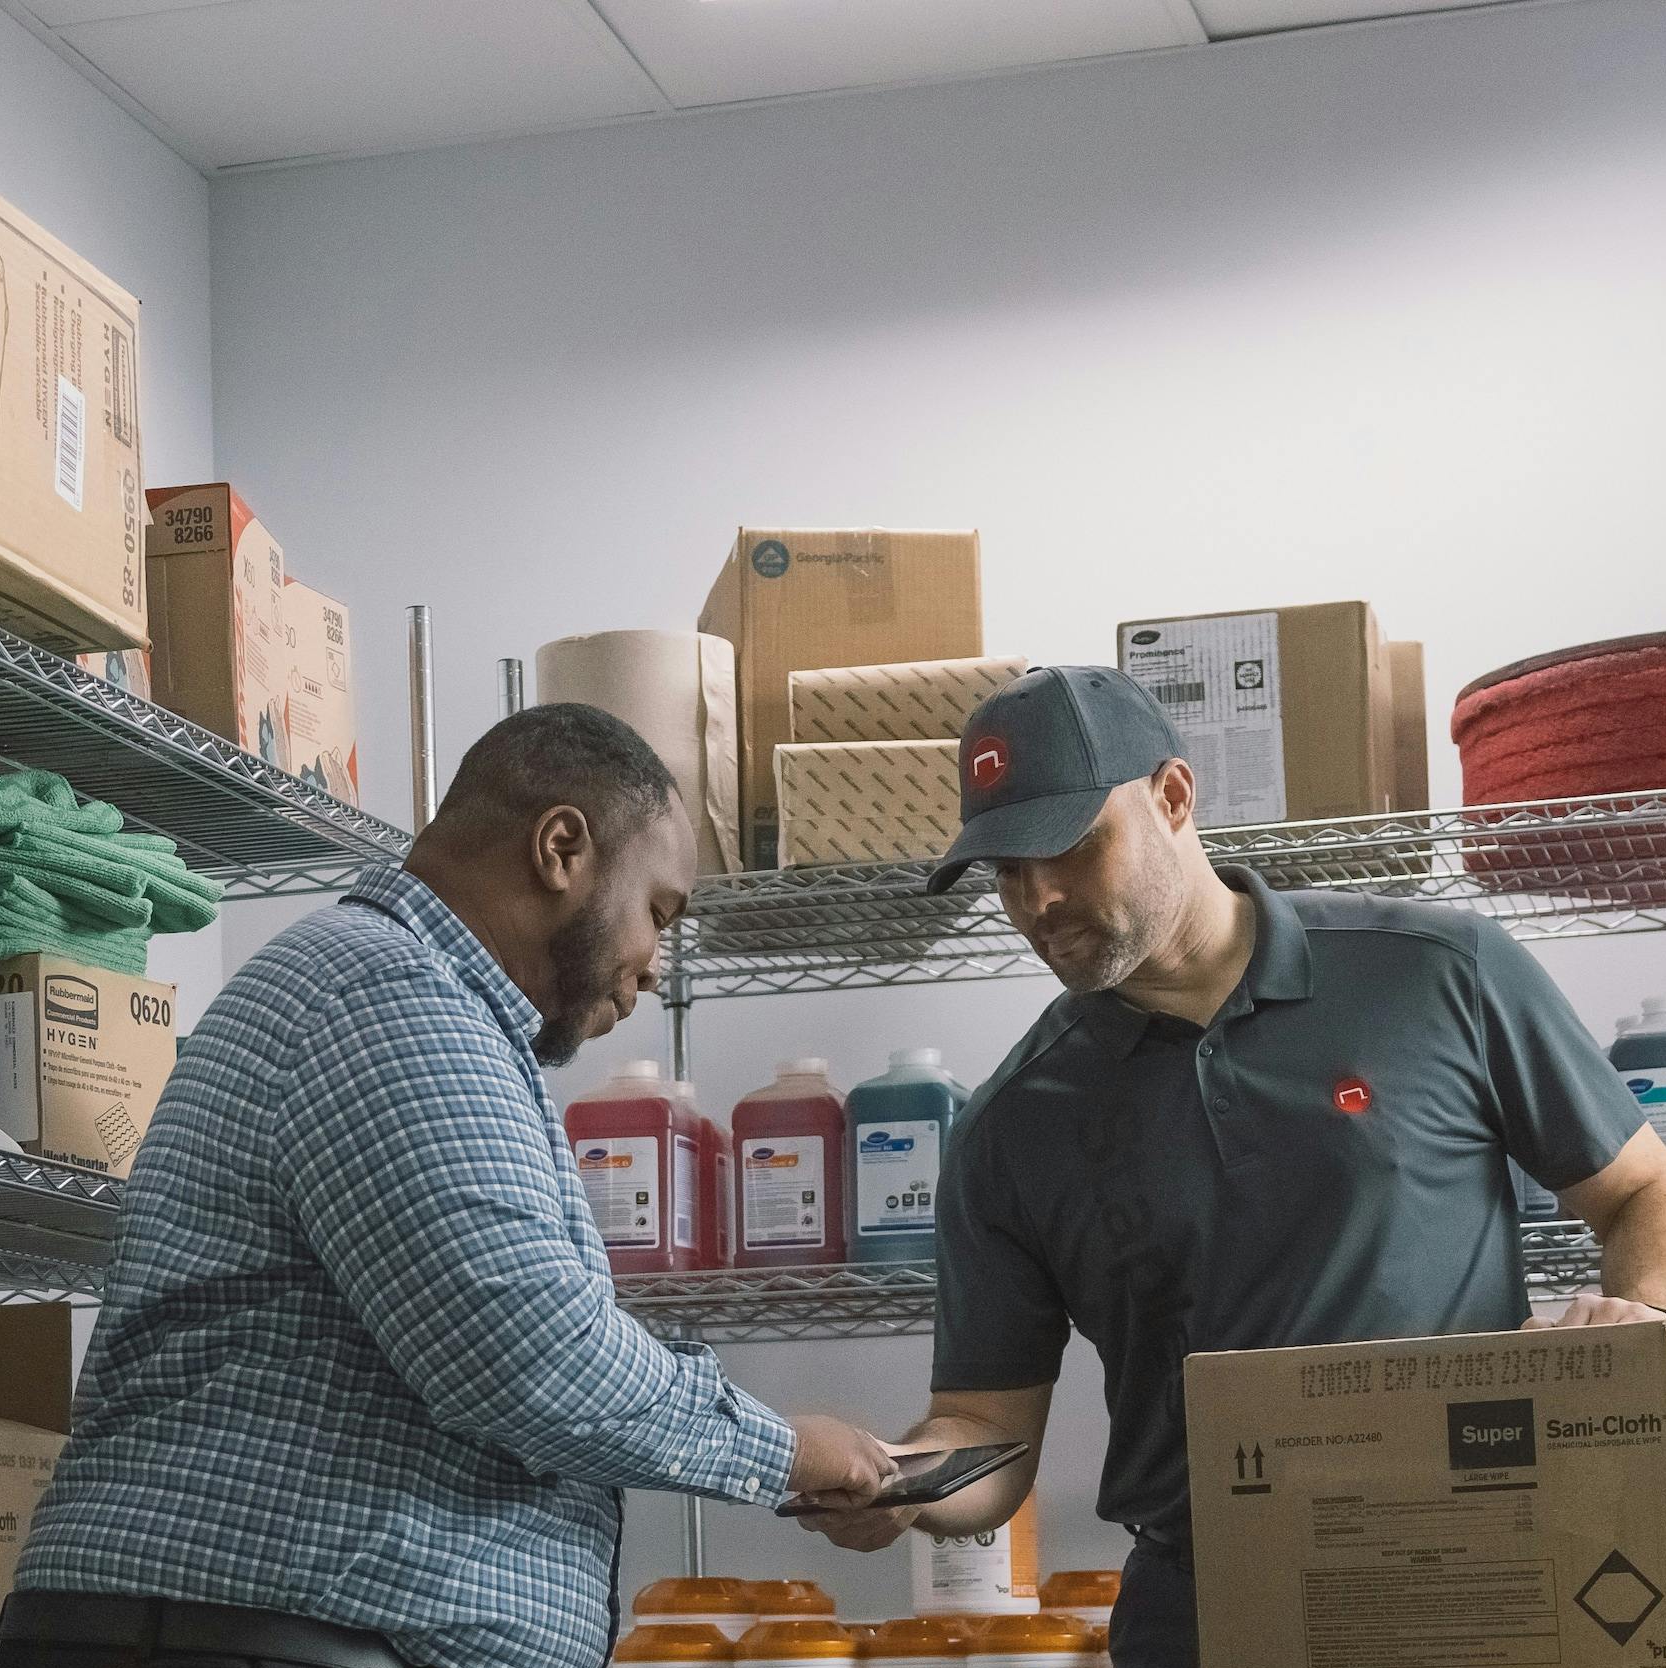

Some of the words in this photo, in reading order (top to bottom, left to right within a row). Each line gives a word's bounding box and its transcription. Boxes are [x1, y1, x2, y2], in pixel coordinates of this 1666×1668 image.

[165, 506, 213, 528] 34790
[122, 467, 135, 607] Q950-88
[174, 524, 213, 544] 8266
[49, 985, 94, 1005] Rubbermaid
[130, 992, 171, 1028] Q620
[47, 1028, 96, 1051] HYGEN
[1384, 1357, 1416, 1391] EXP
[1426, 1352, 1494, 1389] 12/2025
[1462, 1424, 1523, 1447] Super
[1546, 1414, 1661, 1440] Sani-Cloth
[1275, 1434, 1322, 1449] REORDER
[1641, 1436, 1662, 1445] WIPE
[1463, 1473, 1487, 1482] LARGE
[1488, 1471, 1510, 1481] WIPE
